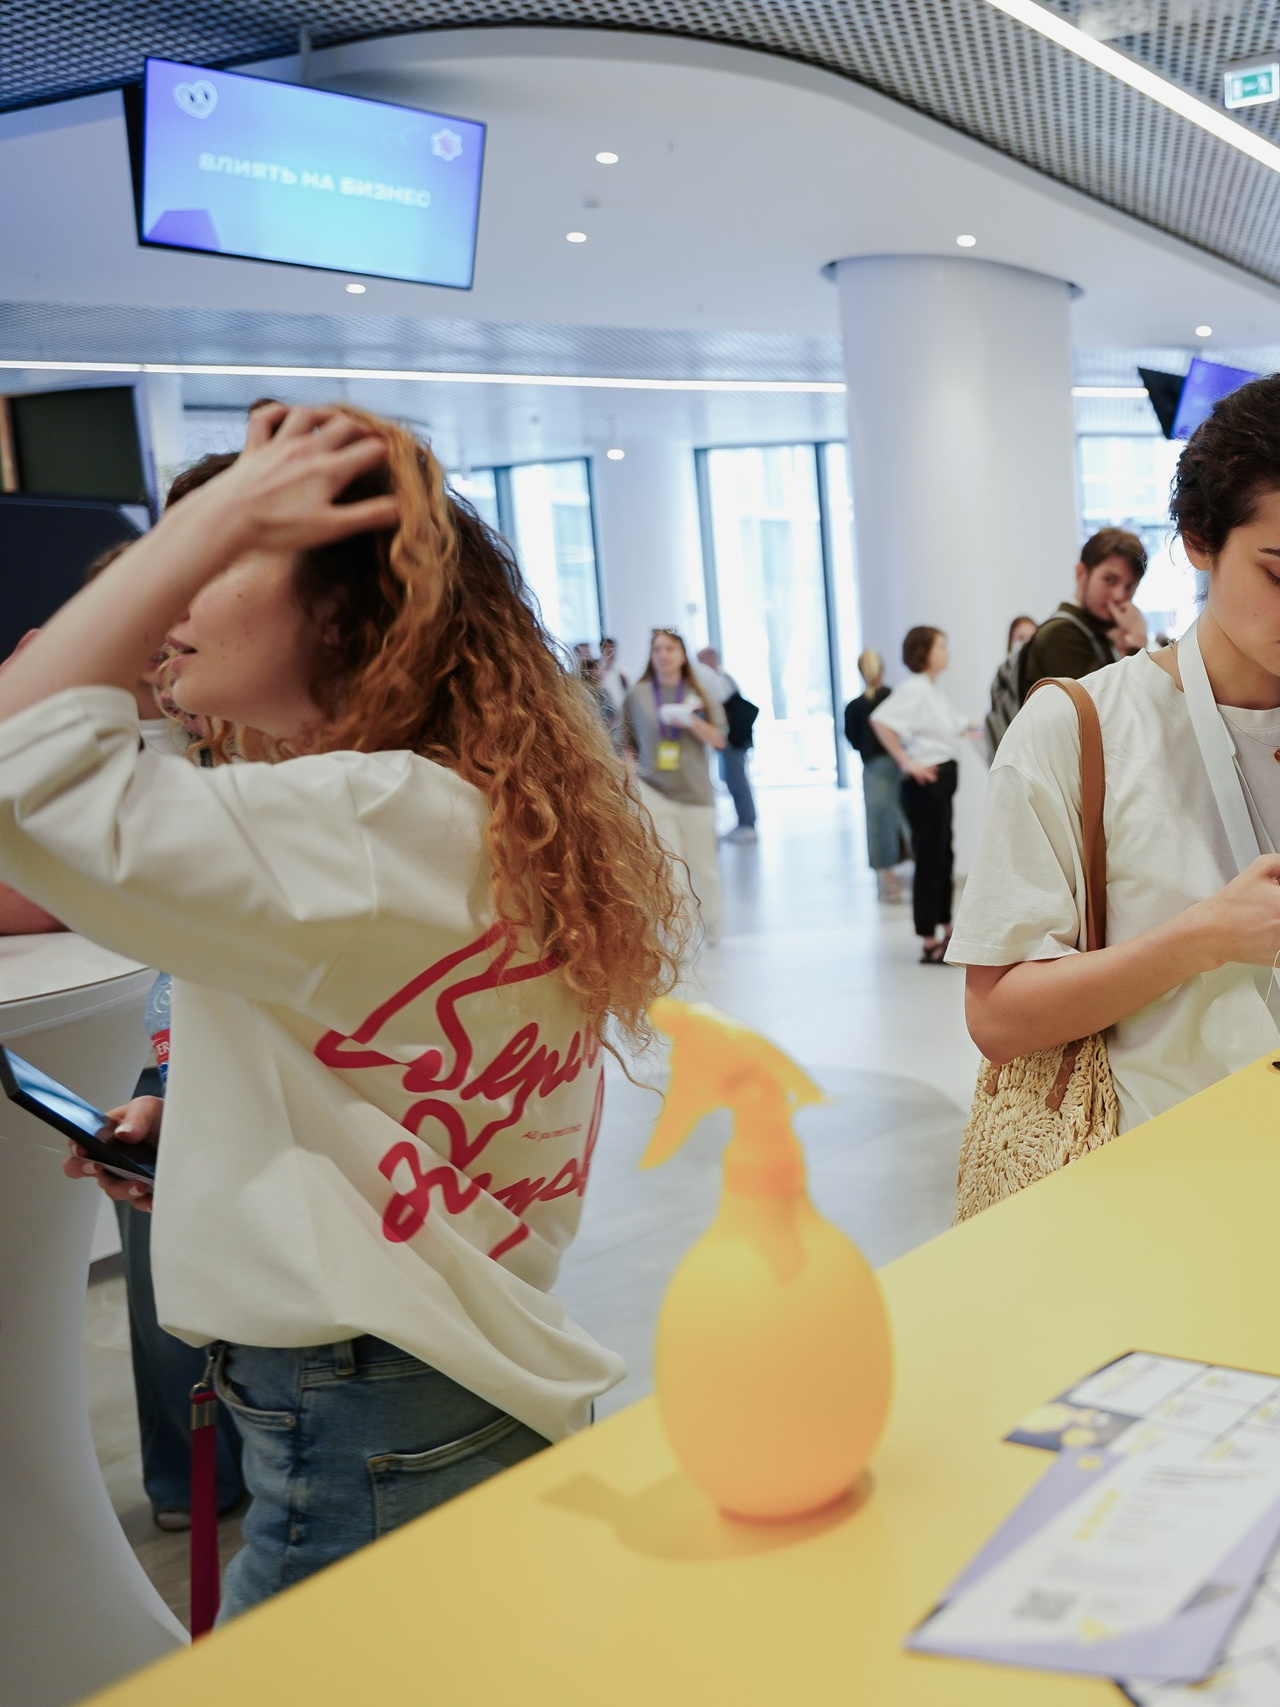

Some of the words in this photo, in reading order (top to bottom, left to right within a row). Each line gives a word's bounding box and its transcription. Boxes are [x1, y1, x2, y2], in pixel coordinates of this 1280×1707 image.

[198, 152, 297, 186] ВЛИЯТЬ
[301, 170, 336, 192] НА
[340, 175, 432, 208] БИЗНЕС
